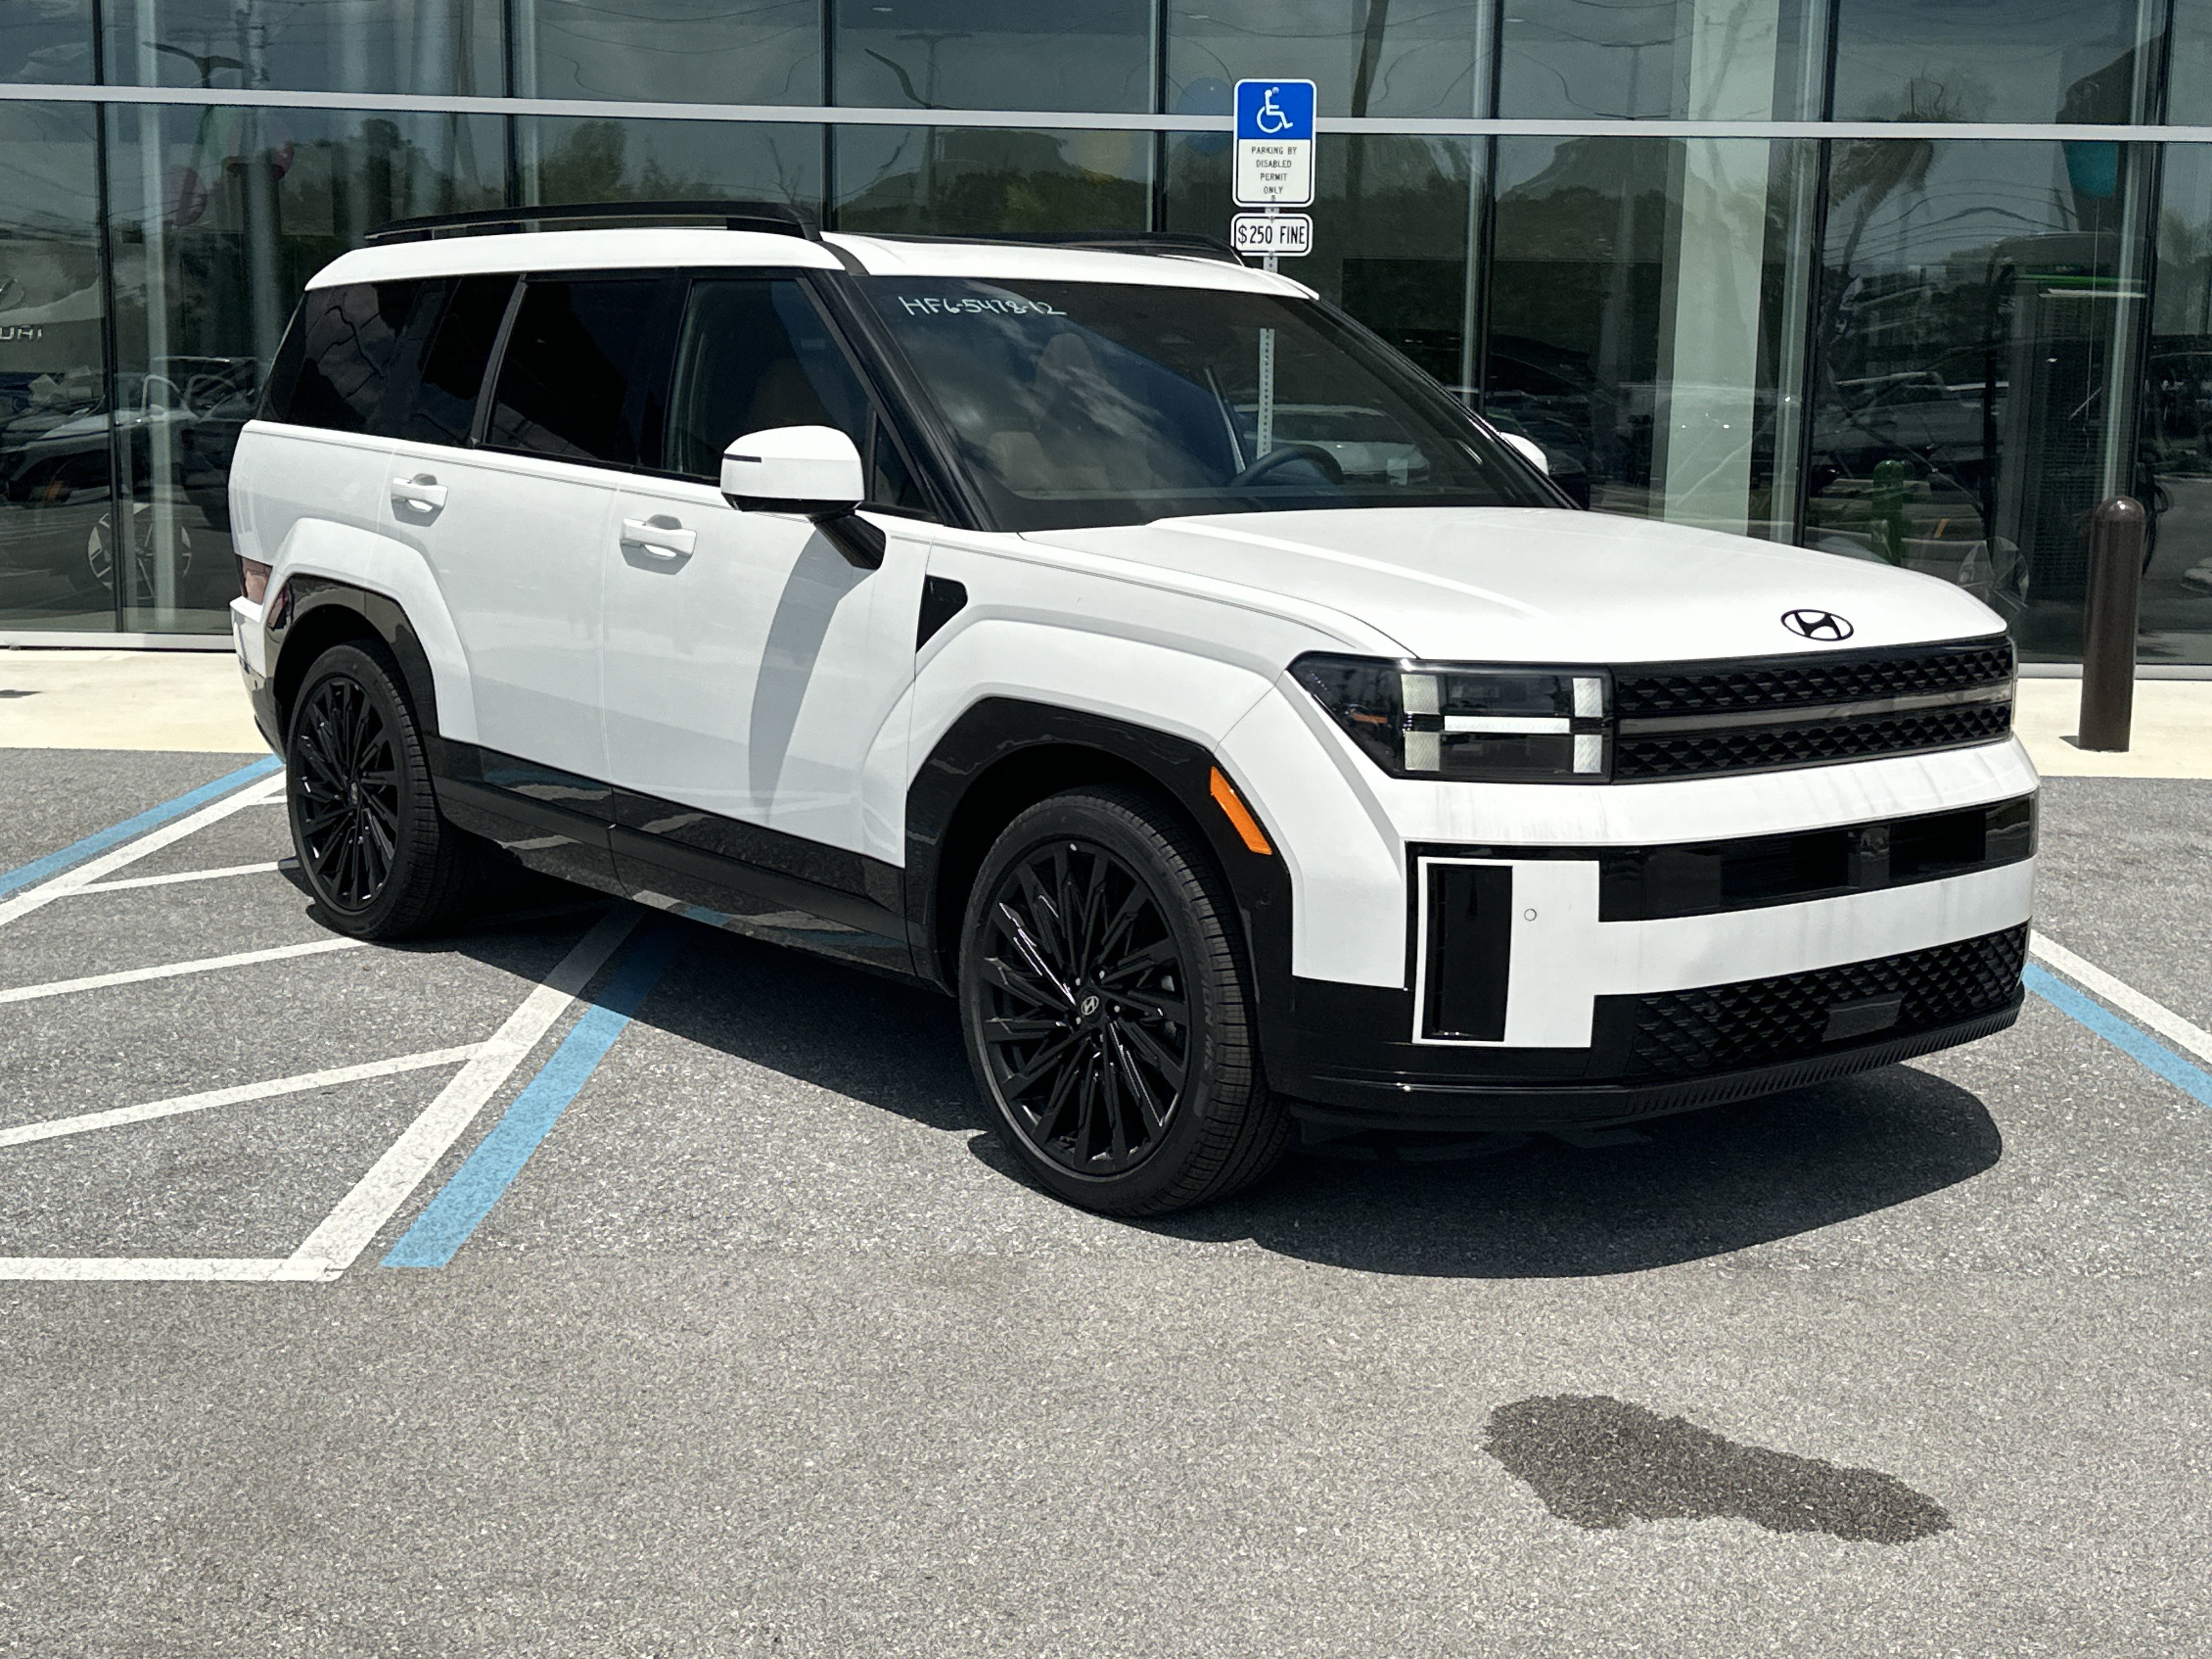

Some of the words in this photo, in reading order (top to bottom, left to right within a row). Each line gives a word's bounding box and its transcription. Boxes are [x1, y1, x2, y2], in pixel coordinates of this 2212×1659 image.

[1251, 146, 1284, 154] PARKING
[1288, 146, 1297, 155] BY
[1256, 159, 1291, 168] DISABLED
[1260, 173, 1287, 181] PERMIT
[1263, 185, 1283, 194] ONLY
[1238, 223, 1273, 246] $250
[1280, 225, 1305, 244] FINE
